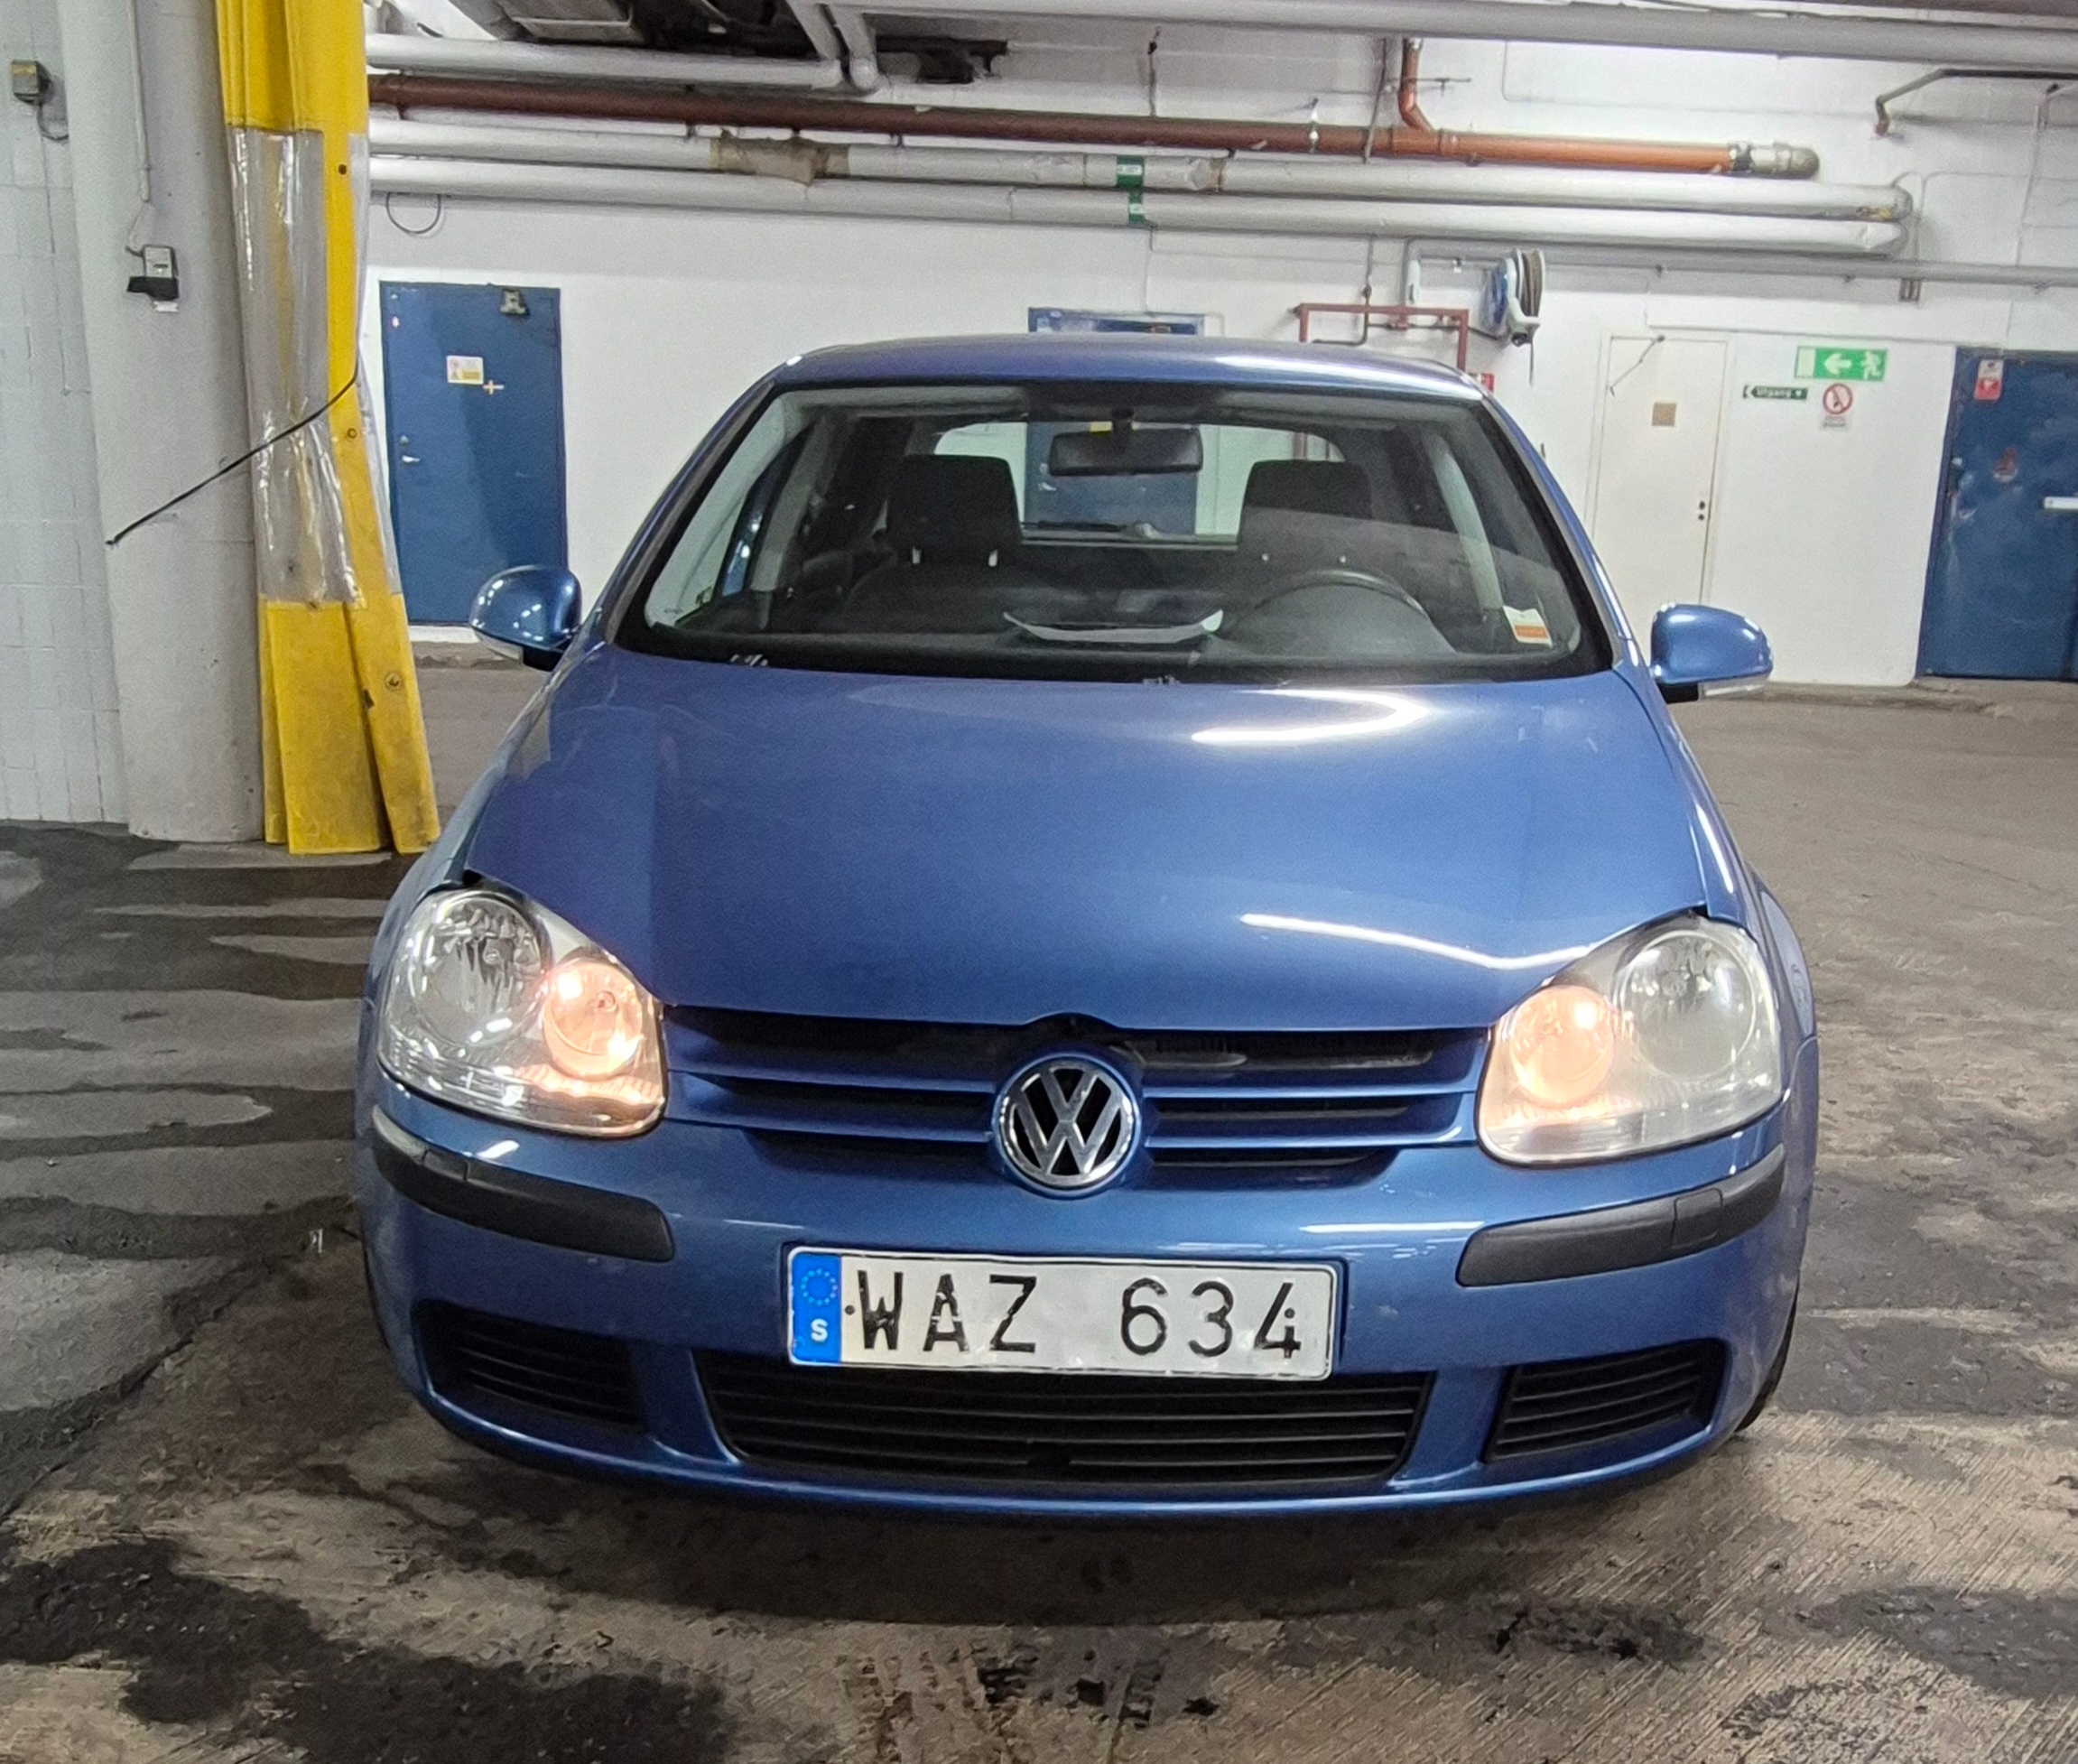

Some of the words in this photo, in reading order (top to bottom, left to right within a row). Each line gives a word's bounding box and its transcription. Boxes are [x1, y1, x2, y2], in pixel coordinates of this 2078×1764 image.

[999, 1059, 1133, 1187] VW
[811, 1318, 829, 1343] S
[858, 1269, 1037, 1353] WAZ
[1120, 1277, 1302, 1359] 634
